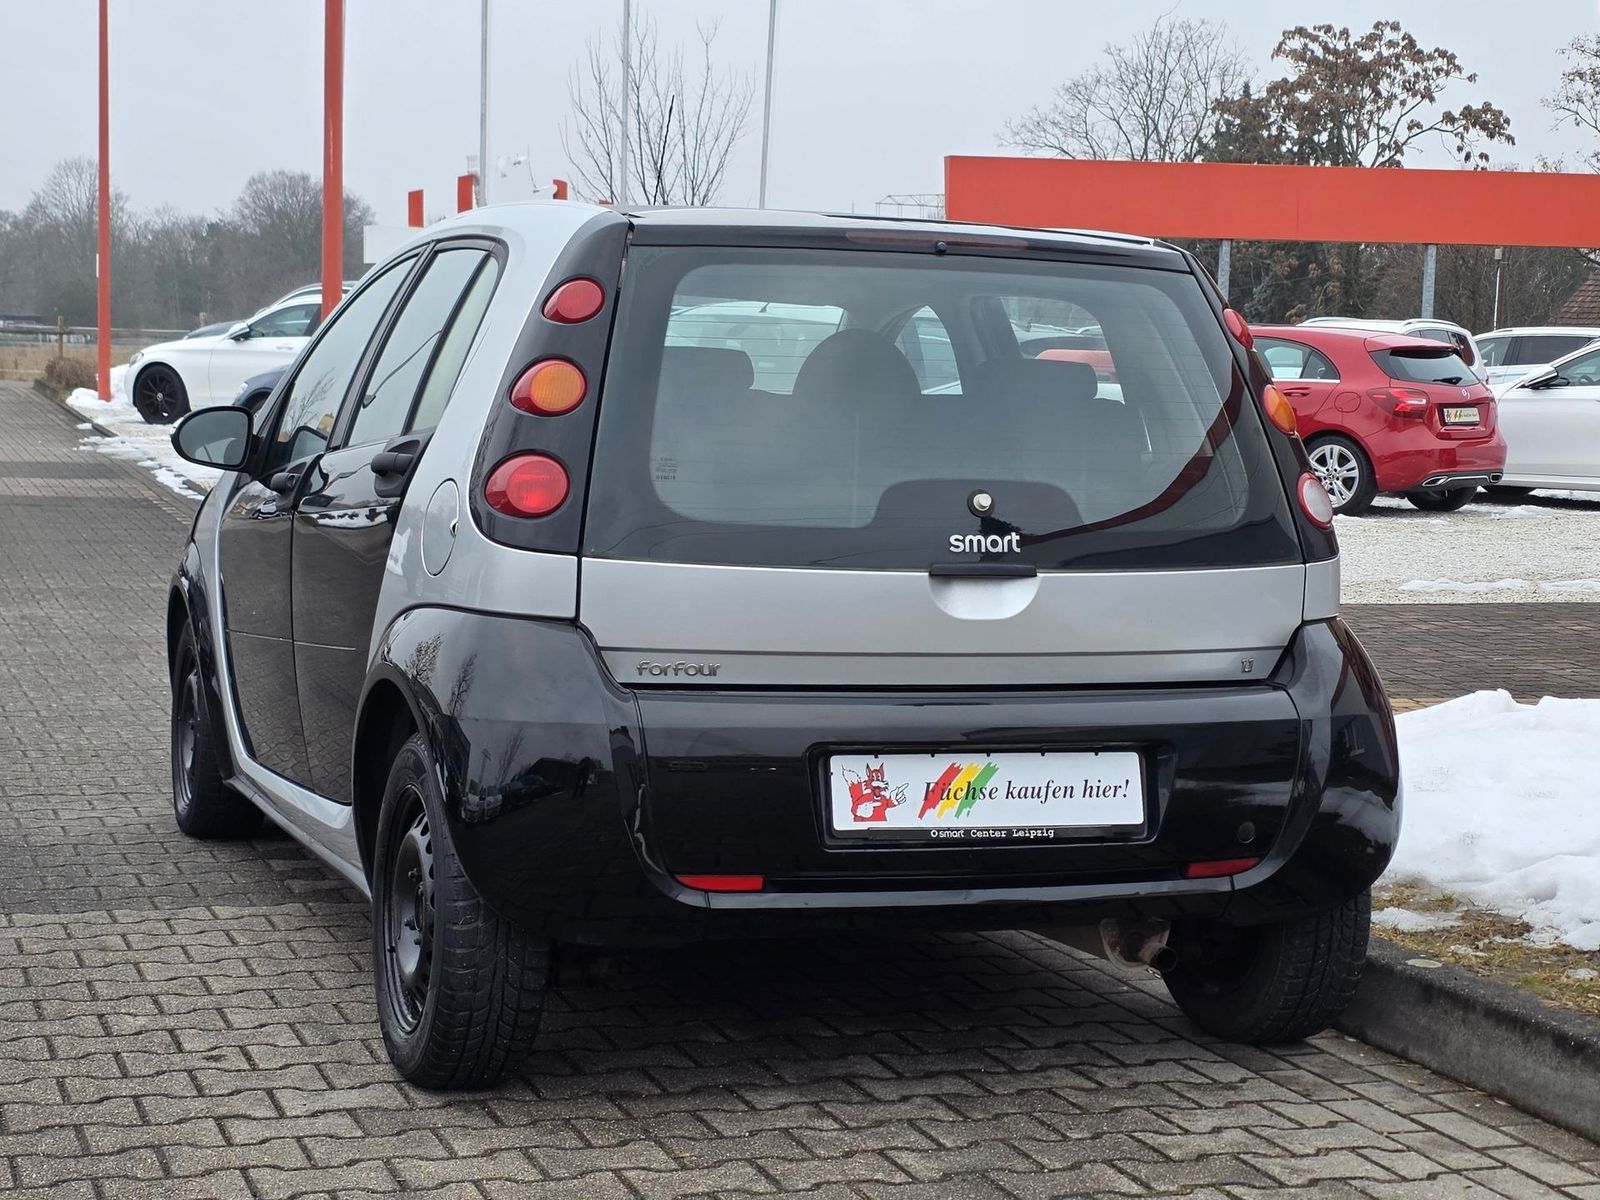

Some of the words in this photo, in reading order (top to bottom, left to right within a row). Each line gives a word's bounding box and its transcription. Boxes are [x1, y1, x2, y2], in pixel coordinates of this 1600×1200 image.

[949, 531, 1021, 553] smart
[636, 659, 721, 676] forfour
[923, 780, 999, 800] Füchse
[1005, 779, 1075, 804] kaufen
[1082, 779, 1129, 799] hier!
[970, 829, 1007, 838] Center
[1012, 828, 1054, 839] Leipzig
